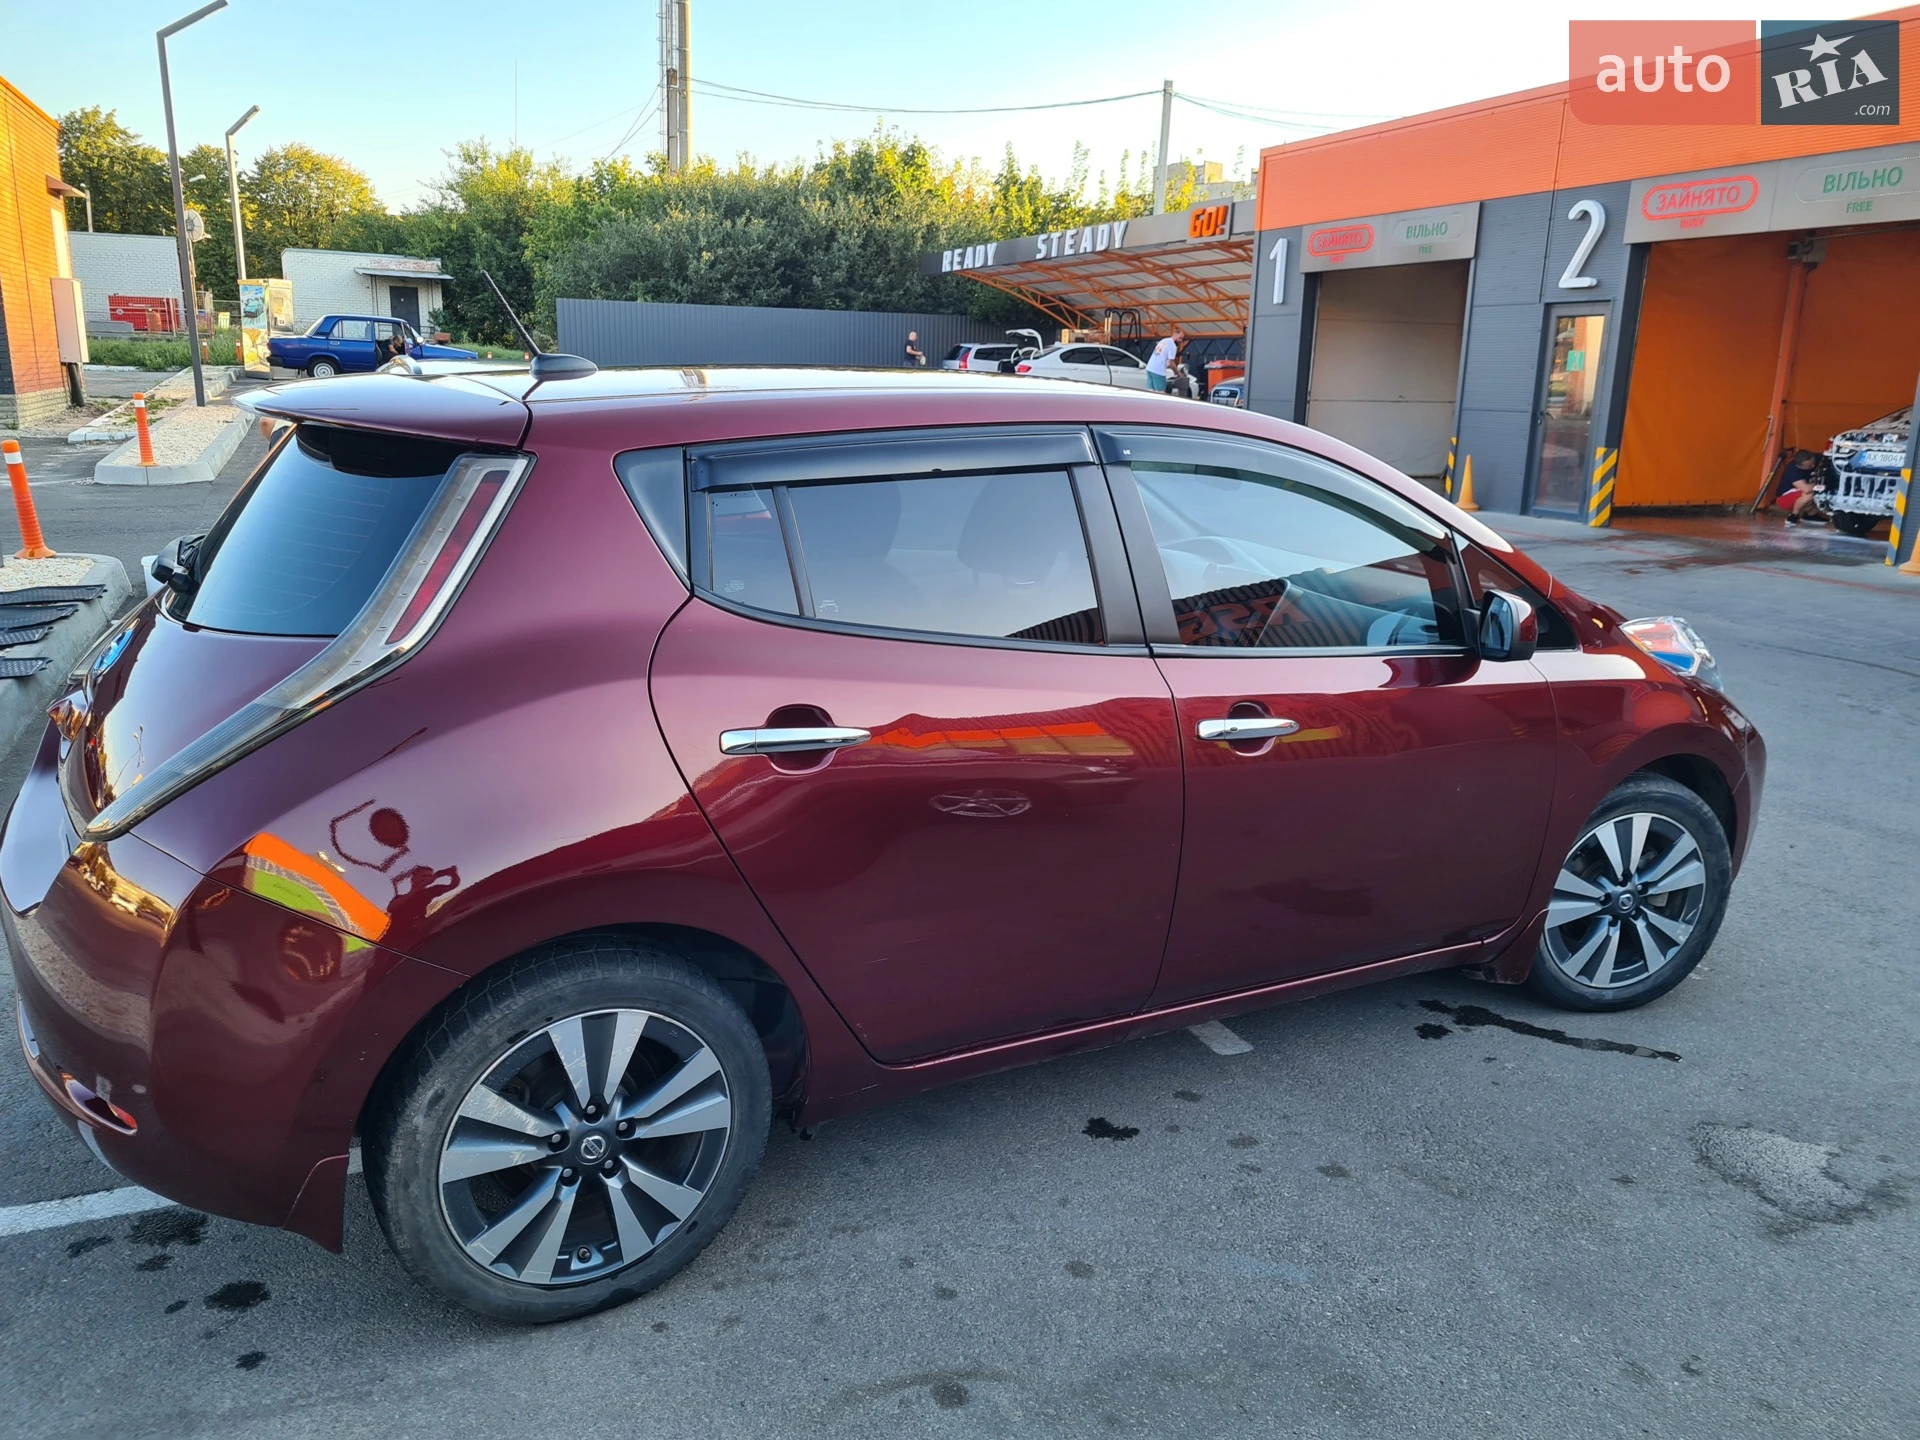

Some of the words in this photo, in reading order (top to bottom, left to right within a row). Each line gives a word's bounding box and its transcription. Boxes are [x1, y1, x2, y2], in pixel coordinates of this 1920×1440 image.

[1822, 166, 1904, 194] ВІЛЬНО
[1655, 185, 1742, 212] ЗАЙНЯТО
[1846, 201, 1874, 214] FREE
[942, 243, 998, 273] READY
[1035, 221, 1129, 260] STEADY
[1189, 204, 1229, 238] GO!
[1406, 221, 1449, 240] ВІЛЬНО
[1558, 199, 1606, 288] 2
[1269, 237, 1289, 305] 1
